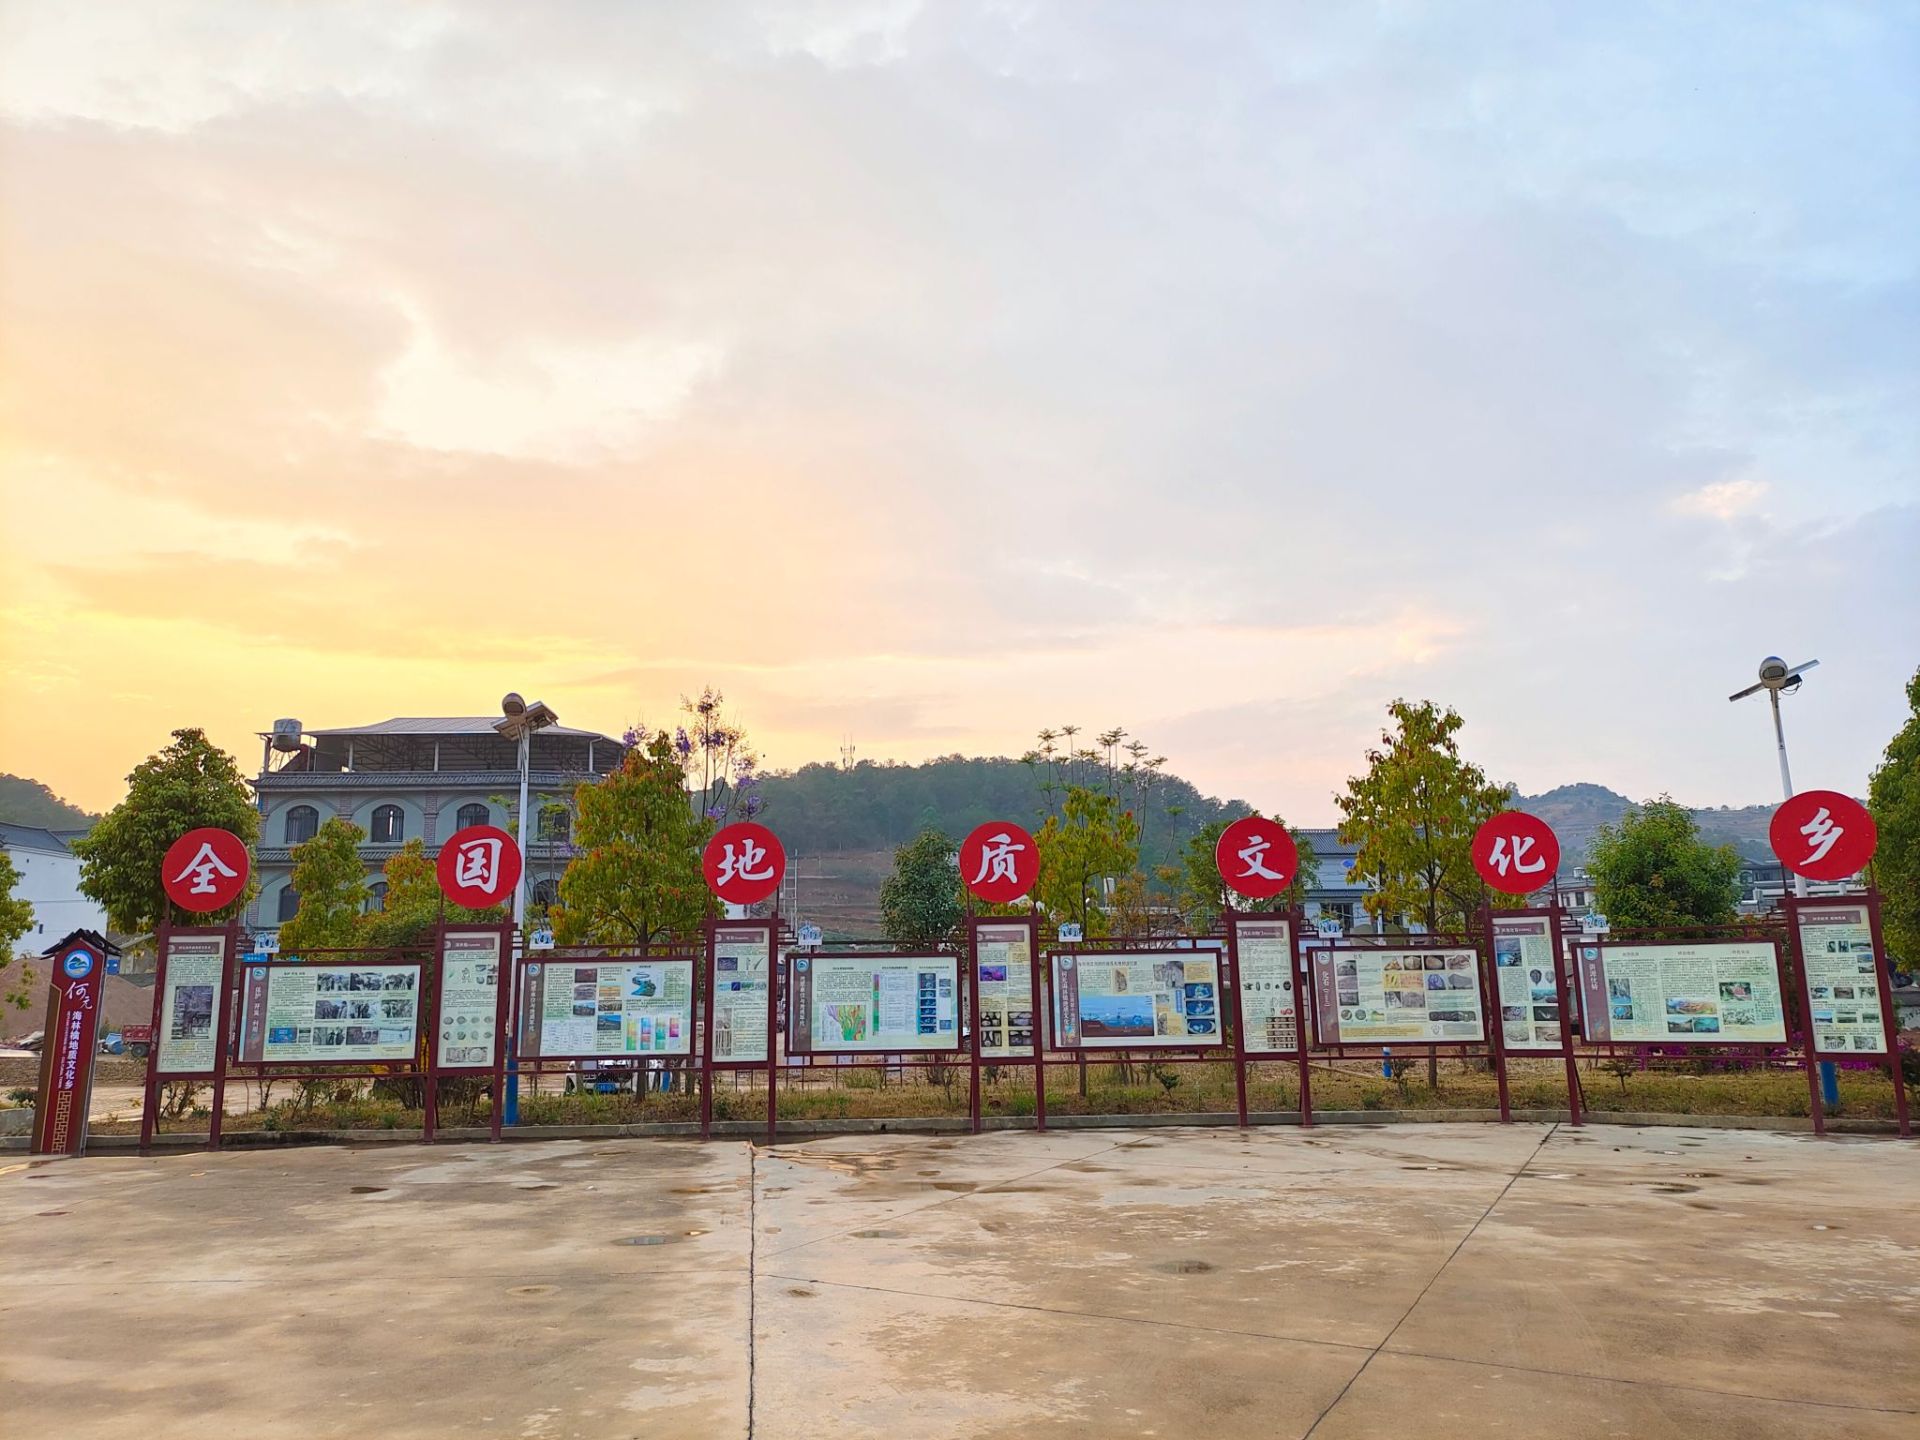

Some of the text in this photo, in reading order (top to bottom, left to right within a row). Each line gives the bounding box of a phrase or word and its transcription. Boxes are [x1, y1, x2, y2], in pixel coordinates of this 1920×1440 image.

[970, 833, 1025, 885] 质
[1236, 835, 1284, 880] 文
[1488, 835, 1546, 877] 化
[1799, 807, 1844, 866] 乡
[172, 843, 239, 894] 全
[456, 838, 503, 894] 国
[716, 838, 774, 887] 地
